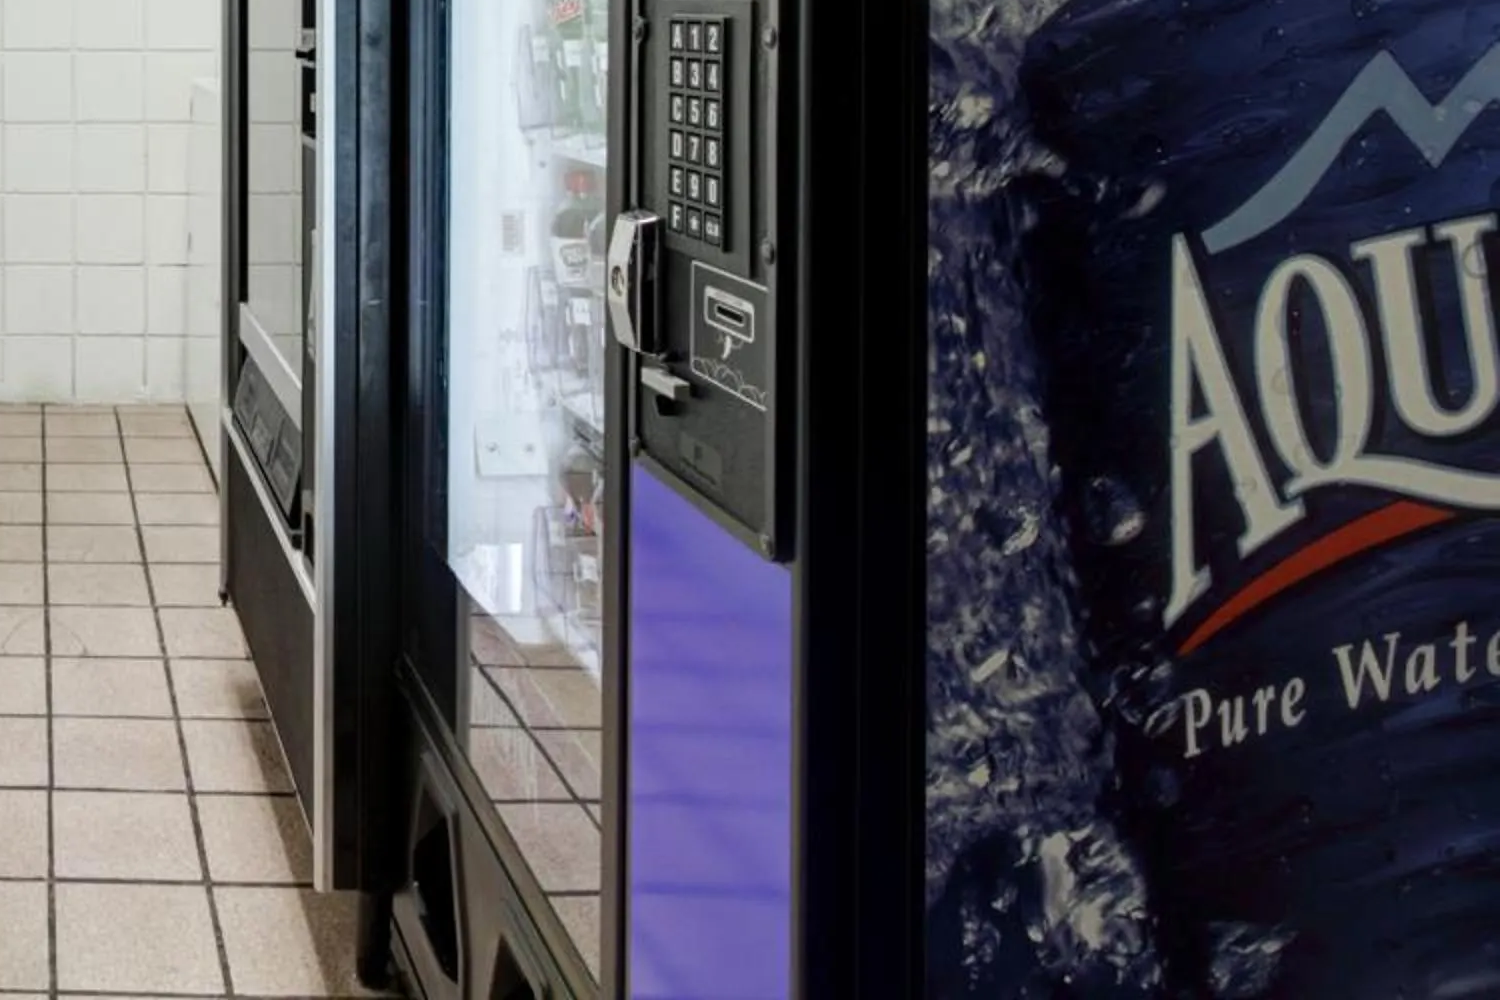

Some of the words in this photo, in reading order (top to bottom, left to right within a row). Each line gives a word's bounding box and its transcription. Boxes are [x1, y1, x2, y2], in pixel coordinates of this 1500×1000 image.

[671, 23, 683, 49] A
[690, 25, 699, 50] 1
[708, 25, 719, 51] 2
[690, 61, 699, 87] 3
[708, 63, 718, 89] 4
[672, 96, 682, 121] C
[690, 99, 700, 124] 5
[708, 102, 718, 128] 6
[672, 131, 682, 157] D
[689, 135, 699, 161] 7
[708, 140, 717, 166] 8
[672, 168, 682, 193] E
[690, 173, 699, 198] 9
[708, 178, 717, 203] 0
[672, 204, 682, 229] F
[1162, 211, 1500, 630] AQU
[1181, 676, 1307, 758] Pure
